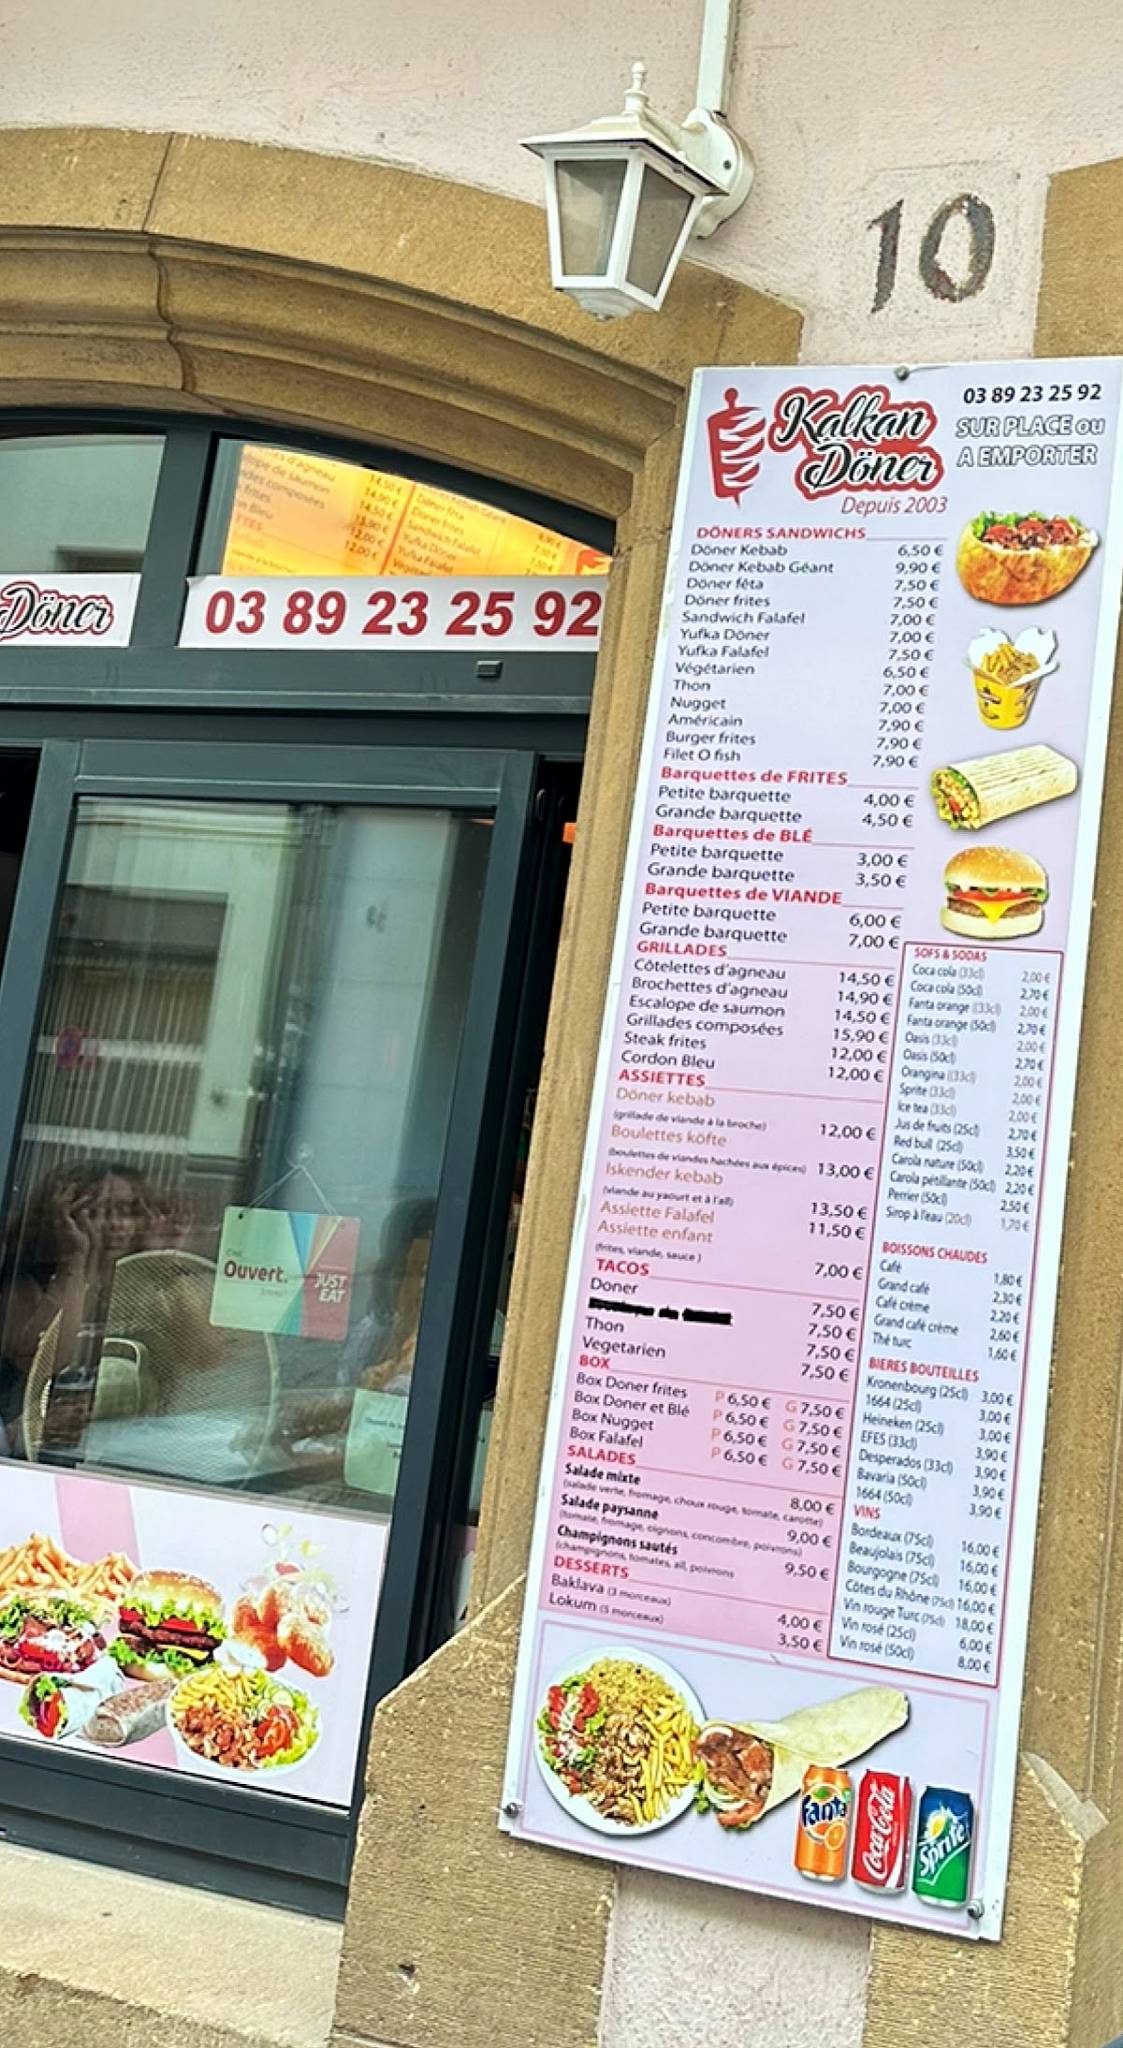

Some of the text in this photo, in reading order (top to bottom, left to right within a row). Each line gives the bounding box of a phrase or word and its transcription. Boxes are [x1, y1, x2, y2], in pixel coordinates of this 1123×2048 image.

[866, 192, 995, 313] 10
[963, 383, 1102, 404] 03 89 23 25 92
[775, 392, 930, 446] Kalkan
[955, 416, 1000, 439] SUR
[1003, 414, 1073, 437] PLACE
[802, 441, 936, 489] Döner
[956, 443, 1098, 468] A EMPORTER
[841, 496, 948, 516] Depuis 2003
[697, 526, 866, 540] DÖNERS SANDWICHS
[688, 561, 834, 574] Döner Kebab Géant
[896, 562, 941, 575] 9,90 €
[0, 588, 107, 633] Döner
[684, 594, 771, 607] Döner frites
[205, 590, 601, 635] 03 89 23 25 92
[682, 610, 806, 625] Sandwich Falafel
[680, 627, 770, 641] Yufka Döner
[675, 662, 756, 676] Végétarien
[673, 679, 711, 692] Thon
[670, 696, 726, 712] Nugget
[668, 713, 743, 727] Américain
[666, 730, 756, 746] Burger frites
[877, 737, 921, 751] 7,90 €
[663, 747, 695, 761] Filet
[714, 749, 741, 762] fish
[661, 766, 848, 786] Barquettes de FRITES
[659, 785, 792, 804] Petite barquette
[864, 794, 914, 808] 4,00 €
[655, 804, 803, 824] Grande barquette
[653, 824, 749, 841] Barquettes
[753, 828, 776, 842] de
[645, 883, 842, 905] Barquettes de VIANDE
[637, 940, 727, 958] GRILLADES
[952, 950, 988, 962] SODAS
[634, 958, 786, 981] Côtelettes d'agneau
[840, 971, 895, 987] 14,50 €
[629, 994, 786, 1017] Escalope de saumon
[626, 1013, 784, 1037] Grillades composées
[624, 1031, 707, 1050] Steak frites
[621, 1050, 715, 1070] Cordon Bleu
[619, 1069, 706, 1088] ASSIETTES
[829, 1066, 884, 1083] 12,00 €
[667, 1091, 716, 1108] kebab
[611, 1124, 683, 1143] Boulettes
[600, 1201, 715, 1224] Assiette Falafel
[597, 1220, 713, 1244] Assiette enfant
[882, 1241, 988, 1264] BOISSONS CHAUDES
[224, 1260, 288, 1284] Ouvert.
[596, 1258, 649, 1277] TACOS
[314, 1272, 348, 1288] JUST
[319, 1288, 345, 1303] EAT
[586, 1316, 625, 1333] Thon
[583, 1336, 666, 1358] Vegetarien
[807, 1343, 855, 1363] 7,50 €
[579, 1354, 611, 1370] BOX
[868, 1357, 979, 1383] BIERES BOUTEILLES
[576, 1372, 602, 1387] Box
[652, 1381, 688, 1399] frites
[569, 1426, 643, 1448] Box Falafel
[860, 1430, 886, 1446] EFES
[567, 1445, 636, 1466] SALADES
[565, 1462, 641, 1486] Salade mixte
[854, 1505, 881, 1520] VINS
[557, 1524, 678, 1556] Champignons sautés
[554, 1555, 629, 1580] DESSERTS
[551, 1573, 605, 1595] Baklava
[549, 1592, 597, 1612] Lokum
[920, 1822, 969, 1876] Sprite
